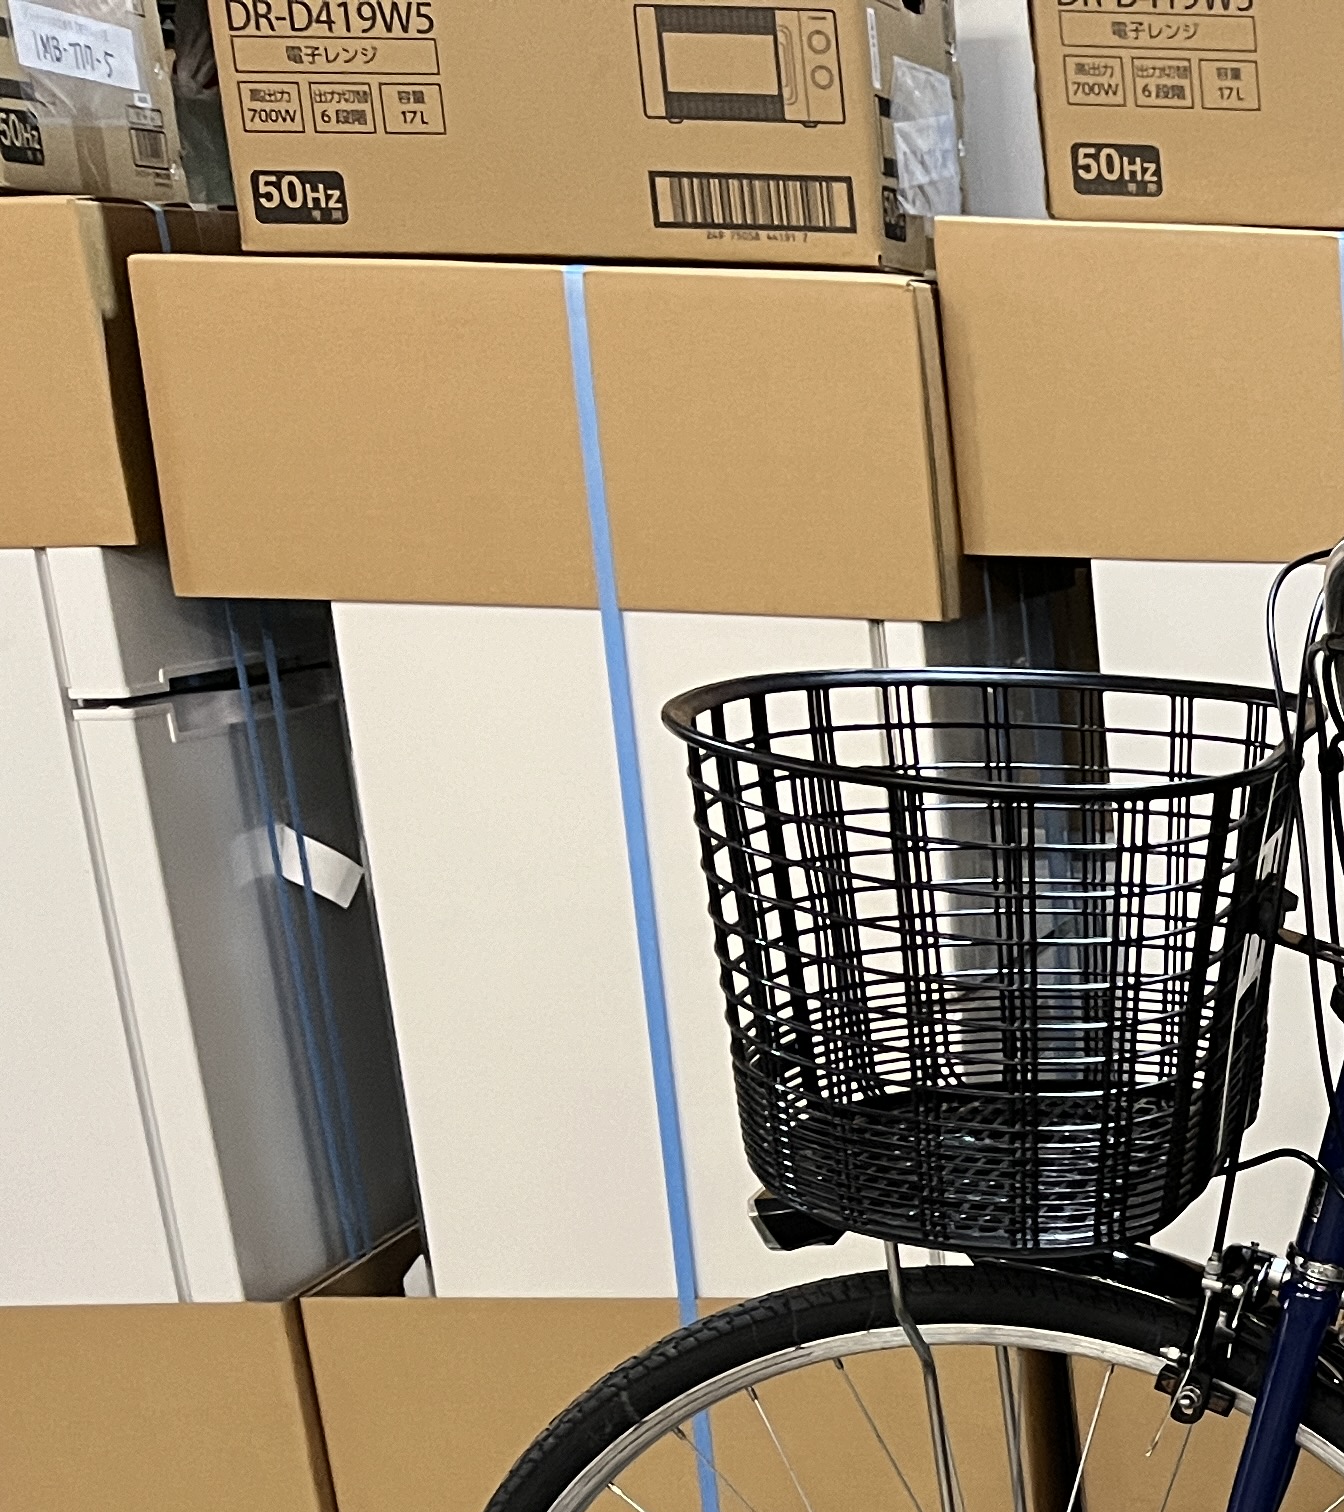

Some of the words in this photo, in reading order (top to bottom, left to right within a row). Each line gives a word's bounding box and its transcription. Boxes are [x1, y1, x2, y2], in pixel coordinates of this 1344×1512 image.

[225, 0, 434, 34] DR-D419W5
[1111, 21, 1199, 40] 電子レンジ
[286, 46, 378, 65] 電子レンジ
[1071, 81, 1120, 97] 700W
[247, 108, 297, 124] 700W
[1076, 147, 1159, 182] 50Hz
[257, 174, 344, 209] 50Hz
